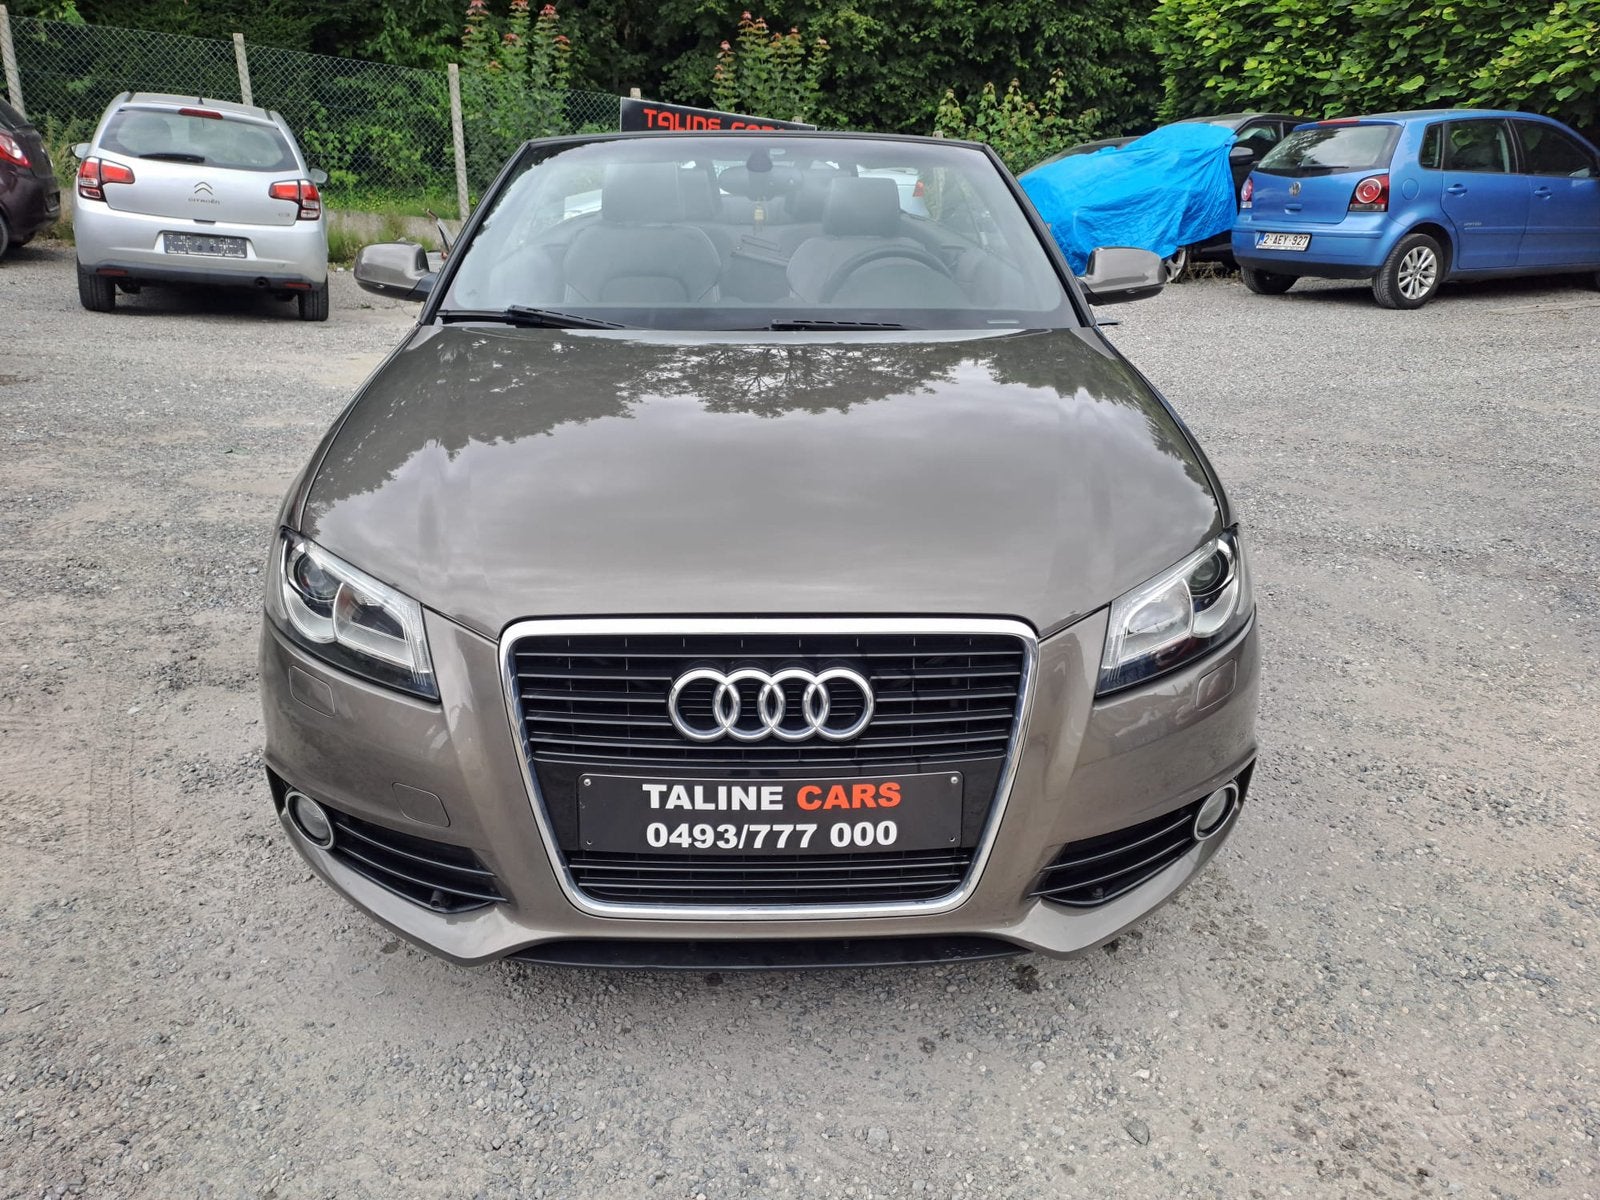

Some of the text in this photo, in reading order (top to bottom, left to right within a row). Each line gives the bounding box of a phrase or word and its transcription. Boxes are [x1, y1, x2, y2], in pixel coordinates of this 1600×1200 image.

[642, 782, 902, 812] TALINE CARS
[645, 820, 898, 850] 0493/777 000
